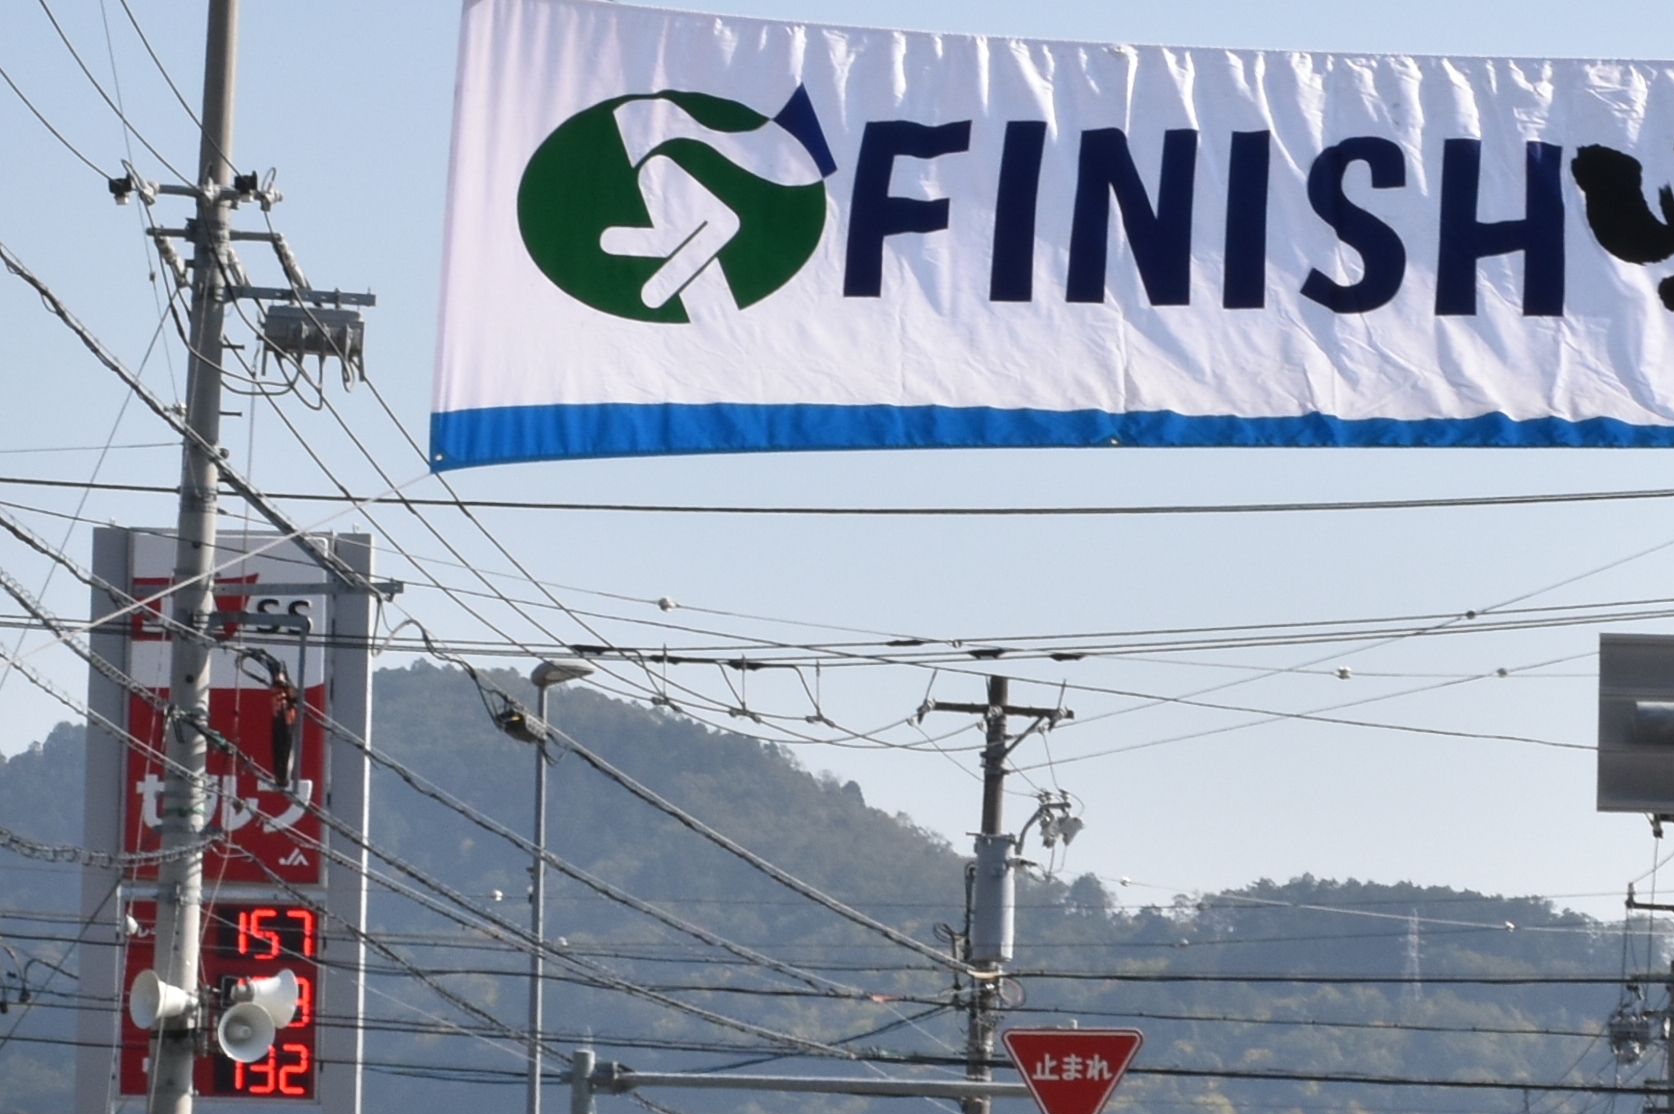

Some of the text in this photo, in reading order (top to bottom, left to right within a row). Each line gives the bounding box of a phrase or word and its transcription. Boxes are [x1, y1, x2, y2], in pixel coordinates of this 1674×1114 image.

[843, 119, 1566, 317] FINISH
[238, 908, 313, 960] 157
[1032, 1053, 1113, 1082] 止まれ
